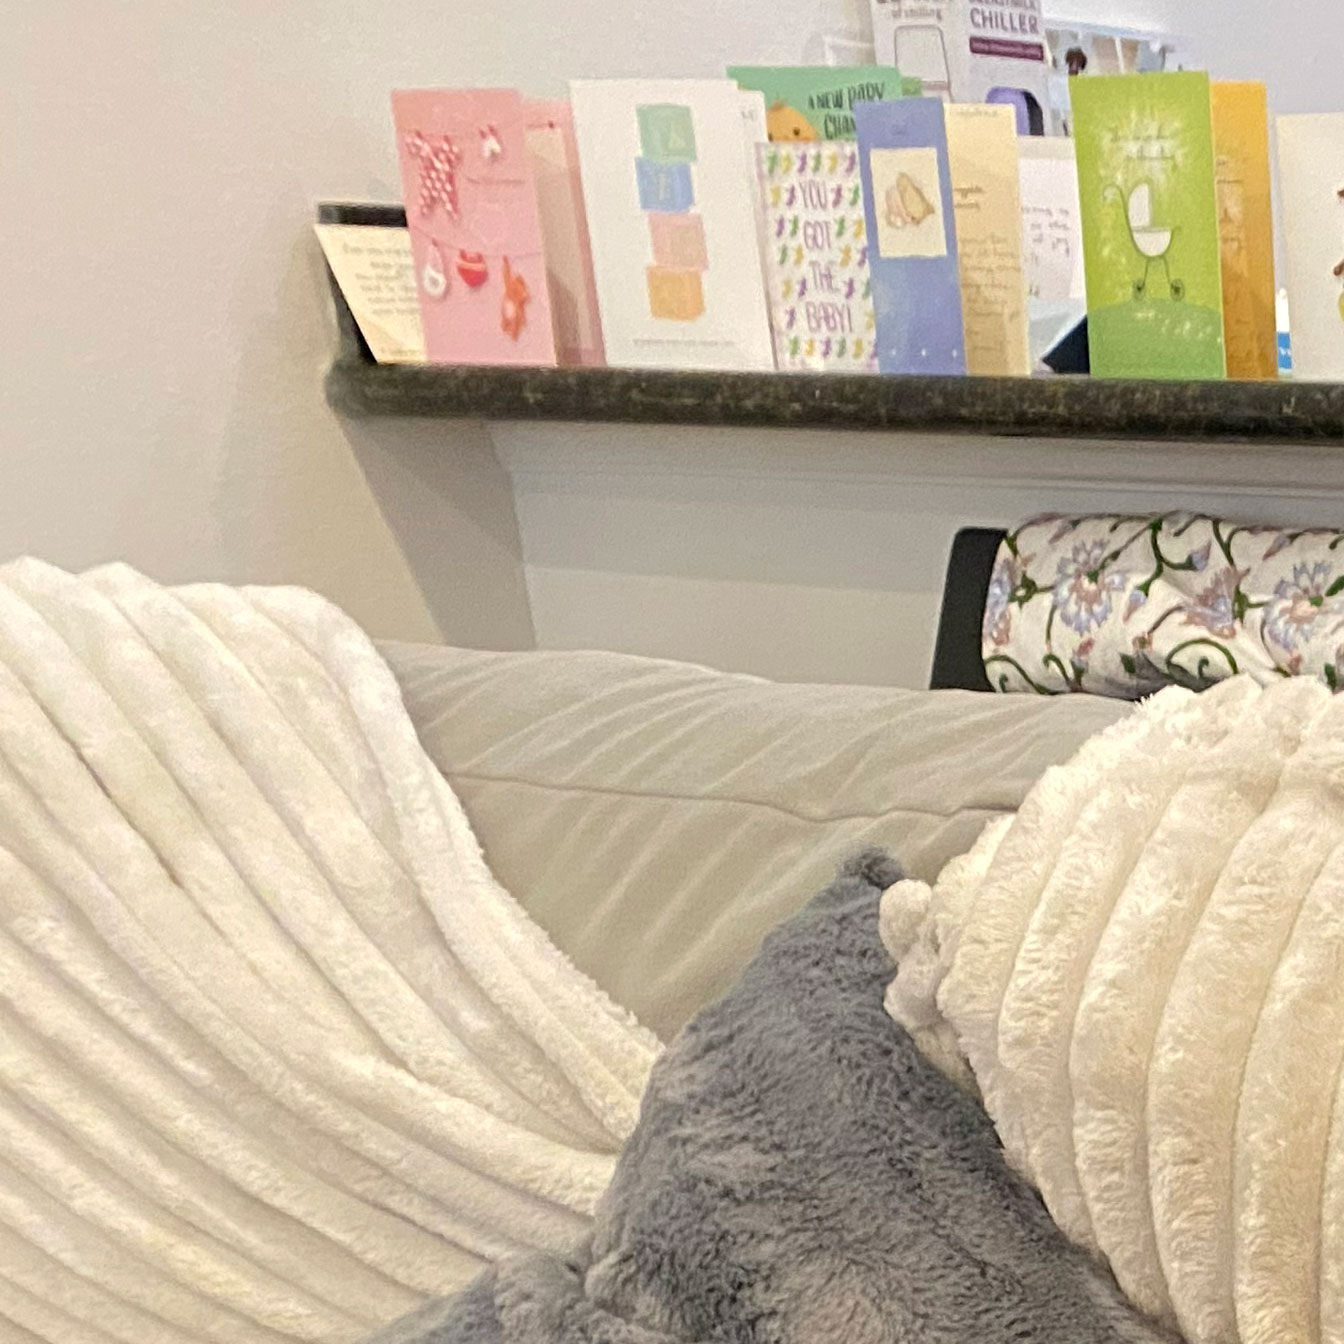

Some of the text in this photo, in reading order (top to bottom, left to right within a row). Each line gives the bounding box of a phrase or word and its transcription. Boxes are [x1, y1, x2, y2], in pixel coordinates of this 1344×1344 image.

[969, 7, 1040, 35] CHILLER
[816, 88, 844, 110] NEW
[799, 179, 828, 211] YOU
[803, 220, 832, 251] GOT
[808, 260, 840, 294] THE
[805, 301, 853, 334] BABY!
